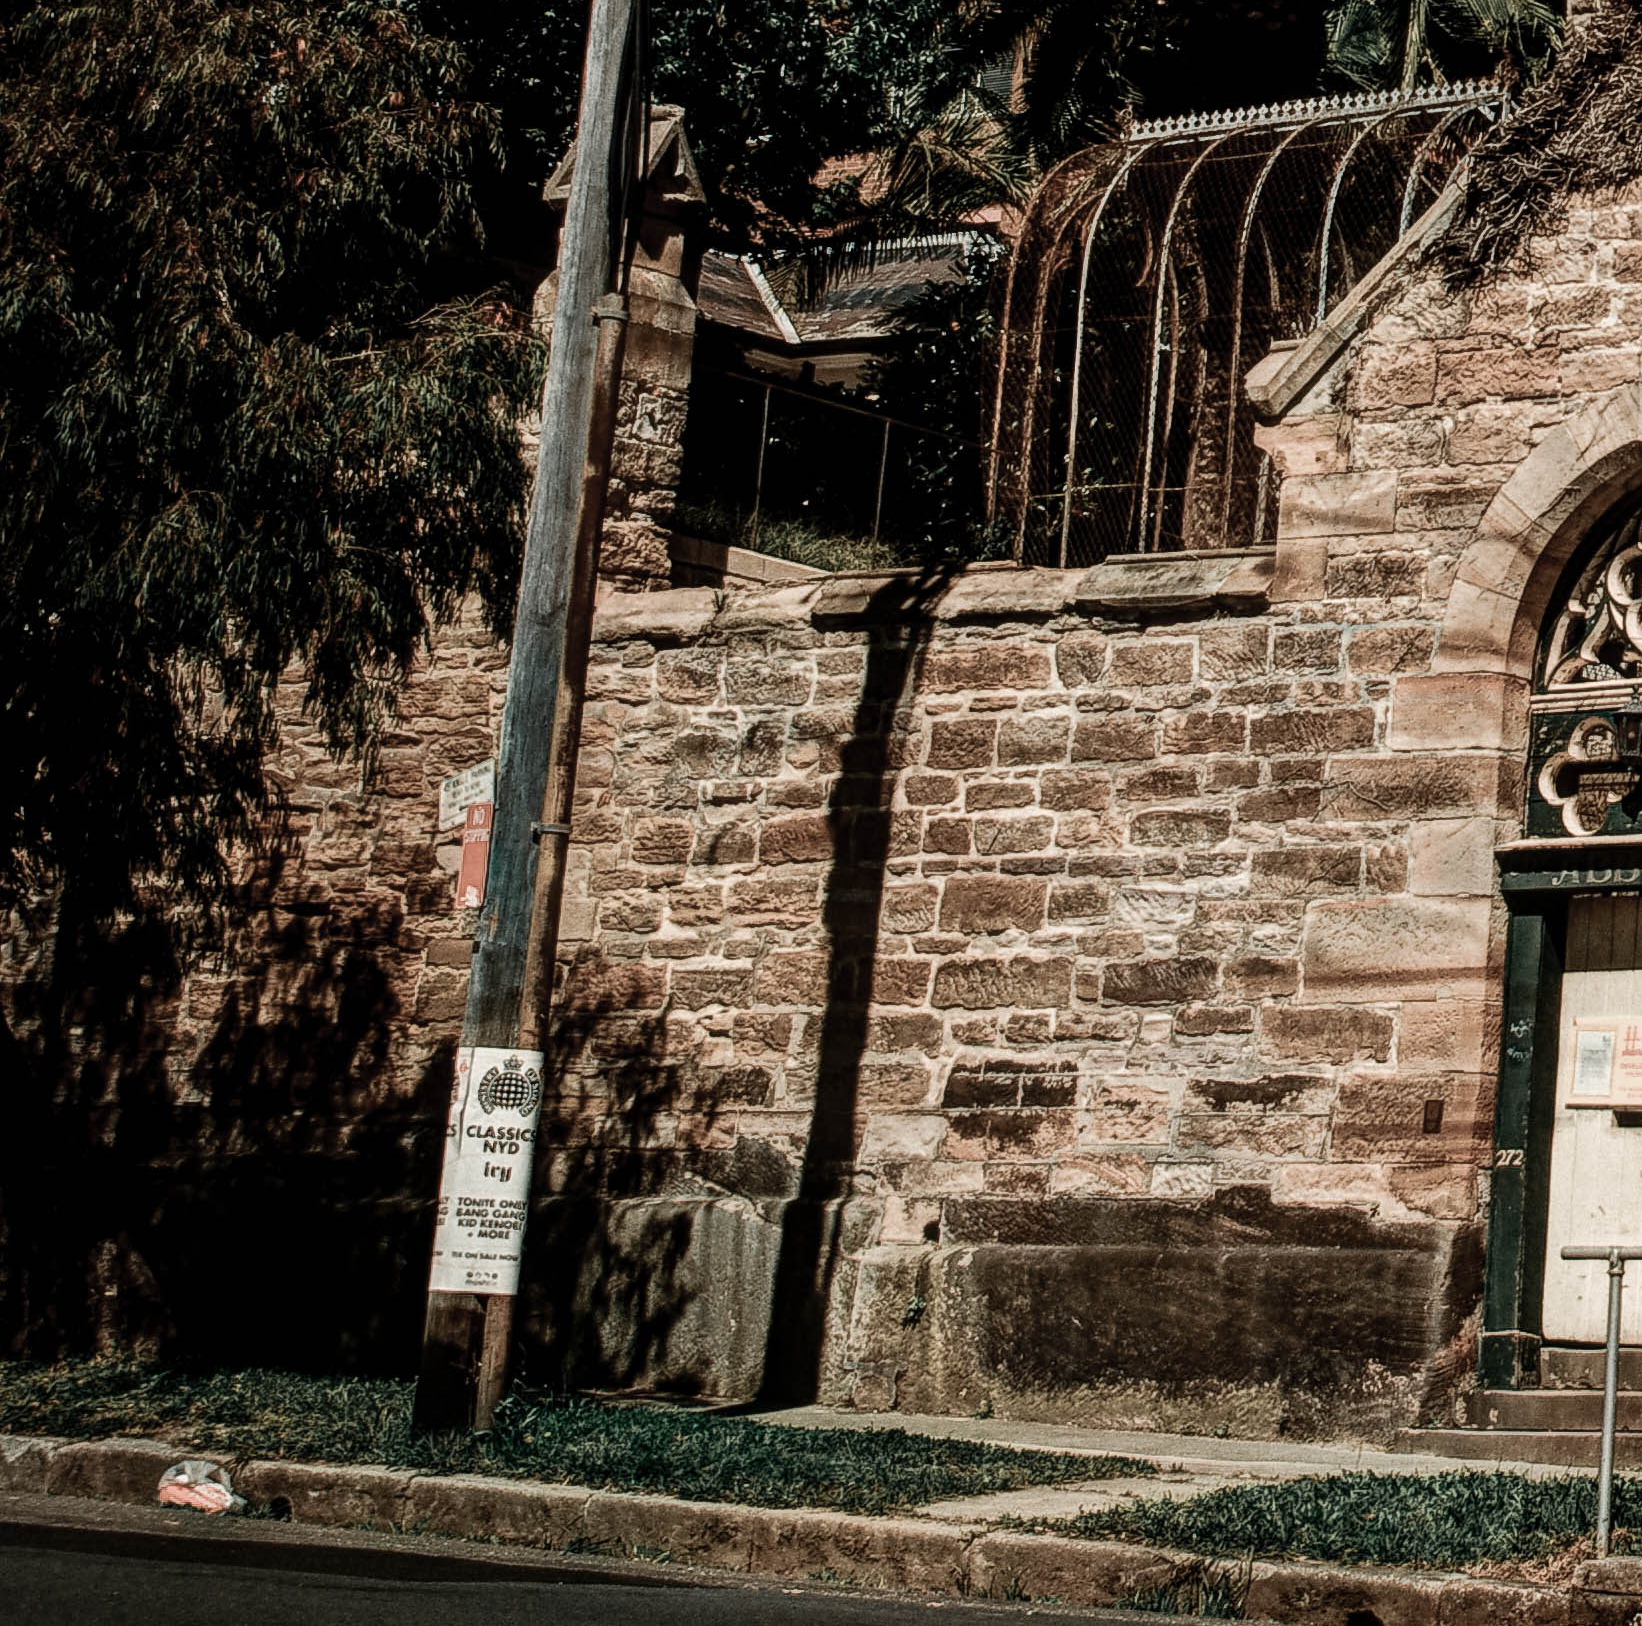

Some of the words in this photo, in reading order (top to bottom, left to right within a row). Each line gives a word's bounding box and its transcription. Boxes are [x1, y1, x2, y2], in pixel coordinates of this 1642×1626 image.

[466, 1124, 537, 1142] CLASSICS
[483, 1140, 520, 1155] NYD
[1495, 1149, 1525, 1167] 272
[457, 1197, 496, 1208] TONITE
[499, 1200, 528, 1210] ONLY
[456, 1208, 489, 1218] BANG
[492, 1210, 526, 1221] GANG
[457, 1219, 477, 1227] KID
[479, 1220, 522, 1231] KENOBI
[477, 1230, 510, 1239] MORE
